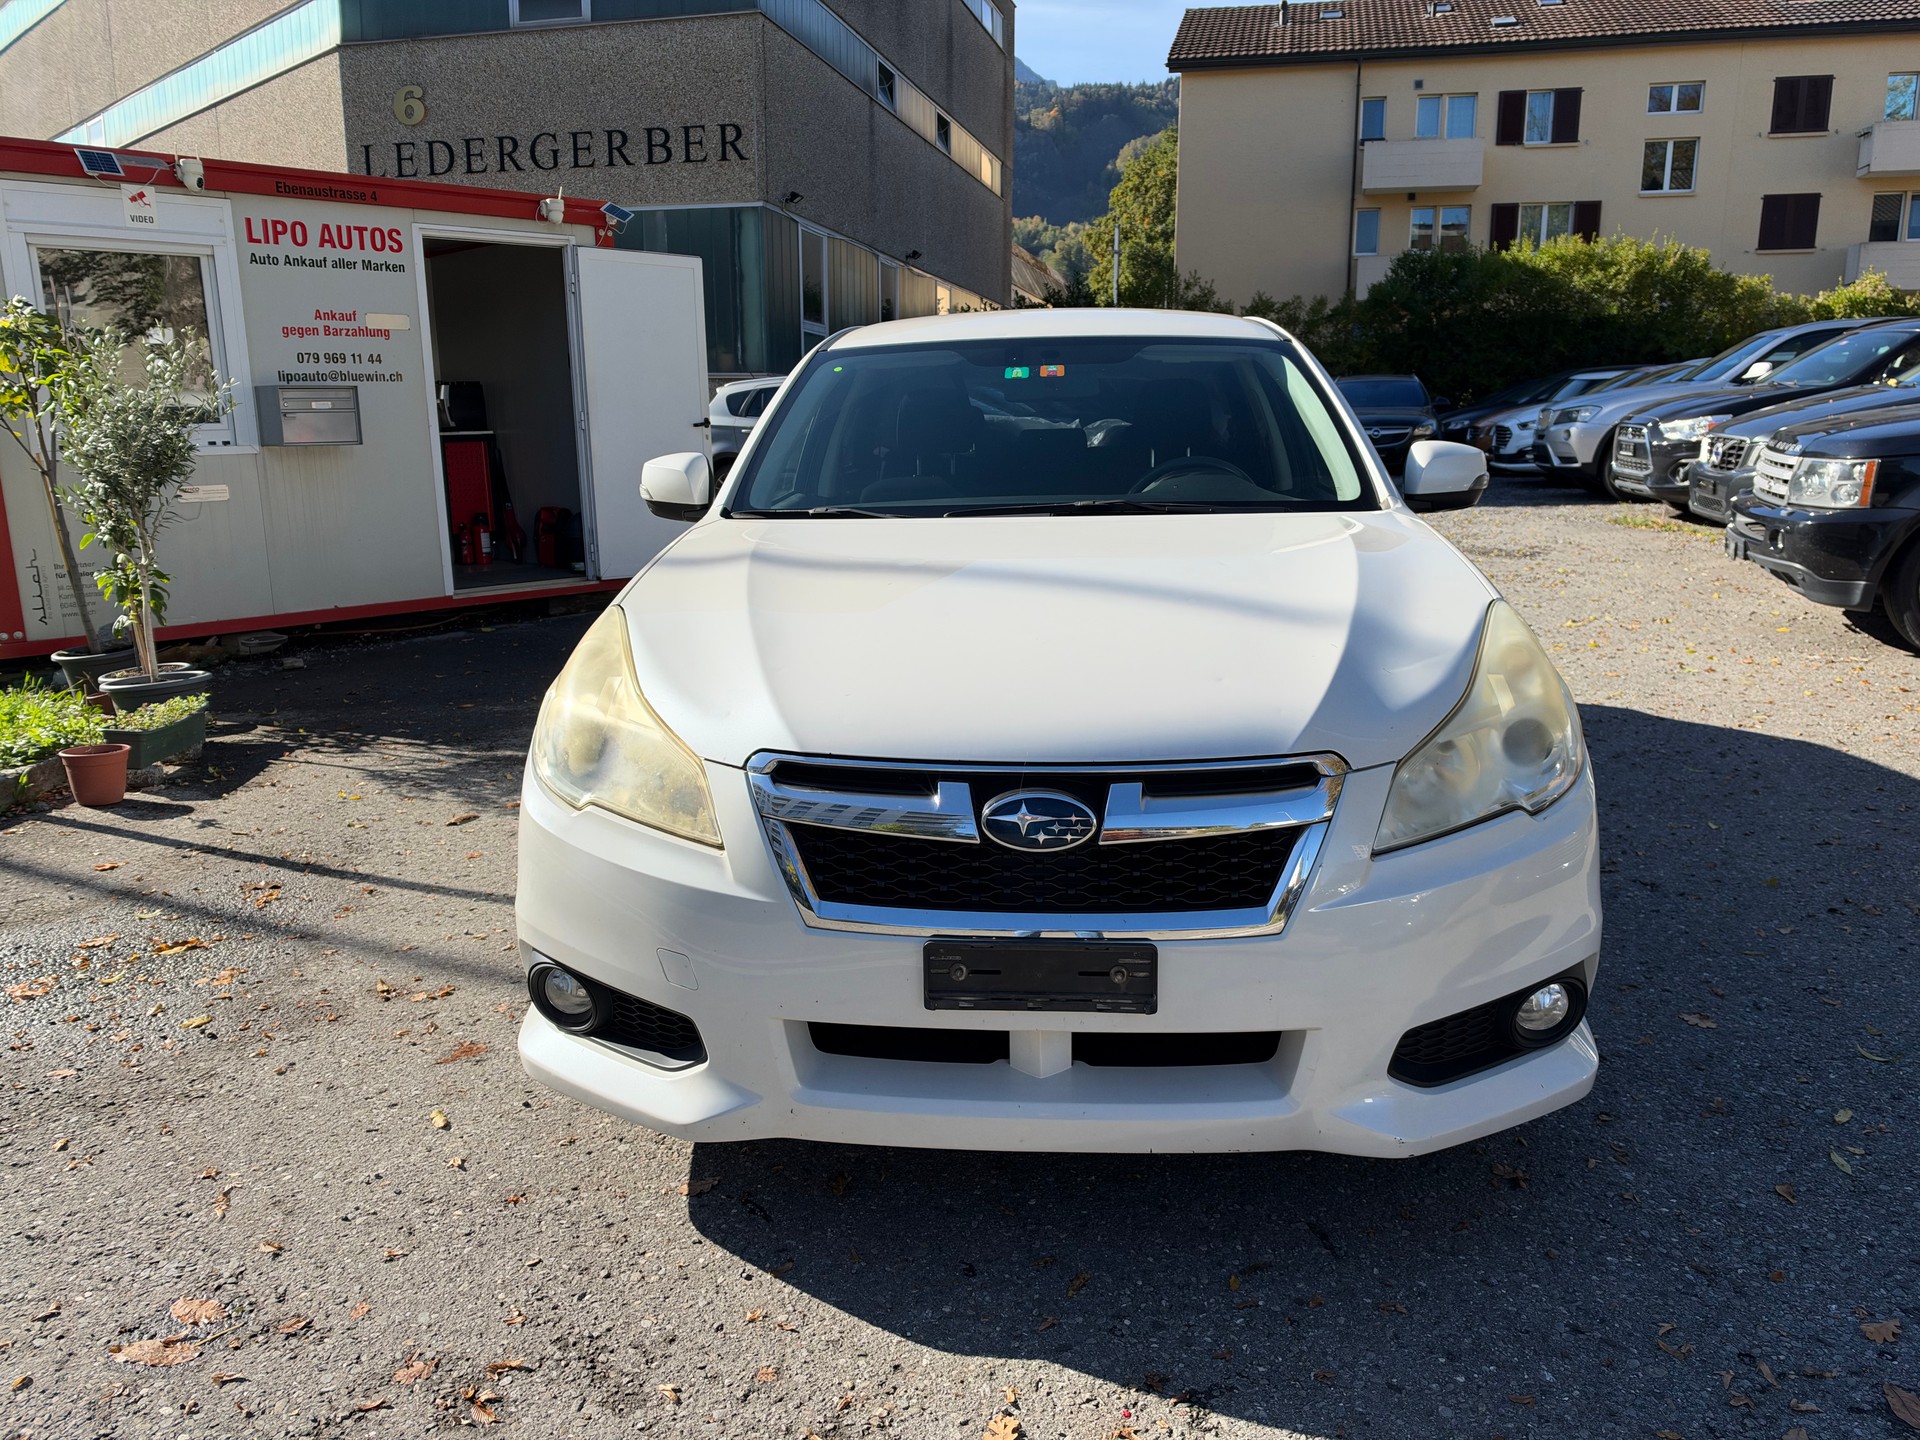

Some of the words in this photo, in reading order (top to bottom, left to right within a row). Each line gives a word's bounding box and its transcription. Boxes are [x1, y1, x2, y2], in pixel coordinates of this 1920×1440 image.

[393, 84, 425, 126] 6
[361, 123, 749, 178] LEDERGERBER
[275, 181, 366, 201] Ebenaustrasse
[371, 191, 377, 202] 4
[129, 214, 154, 224] VIDEO
[244, 217, 308, 247] LIPO
[318, 223, 403, 253] AUTOS
[250, 252, 279, 266] Auto
[284, 254, 327, 268] Ankauf
[331, 257, 357, 270] aller
[362, 259, 405, 273] Marken
[314, 309, 357, 322] Ankauf
[282, 325, 319, 338] gegen
[323, 325, 391, 340] Barzahlung
[297, 352, 320, 364] 079
[323, 352, 346, 364] 969
[350, 353, 362, 364] 11
[367, 353, 382, 365] 44
[277, 370, 403, 384] lipoauto@bluewin.ch
